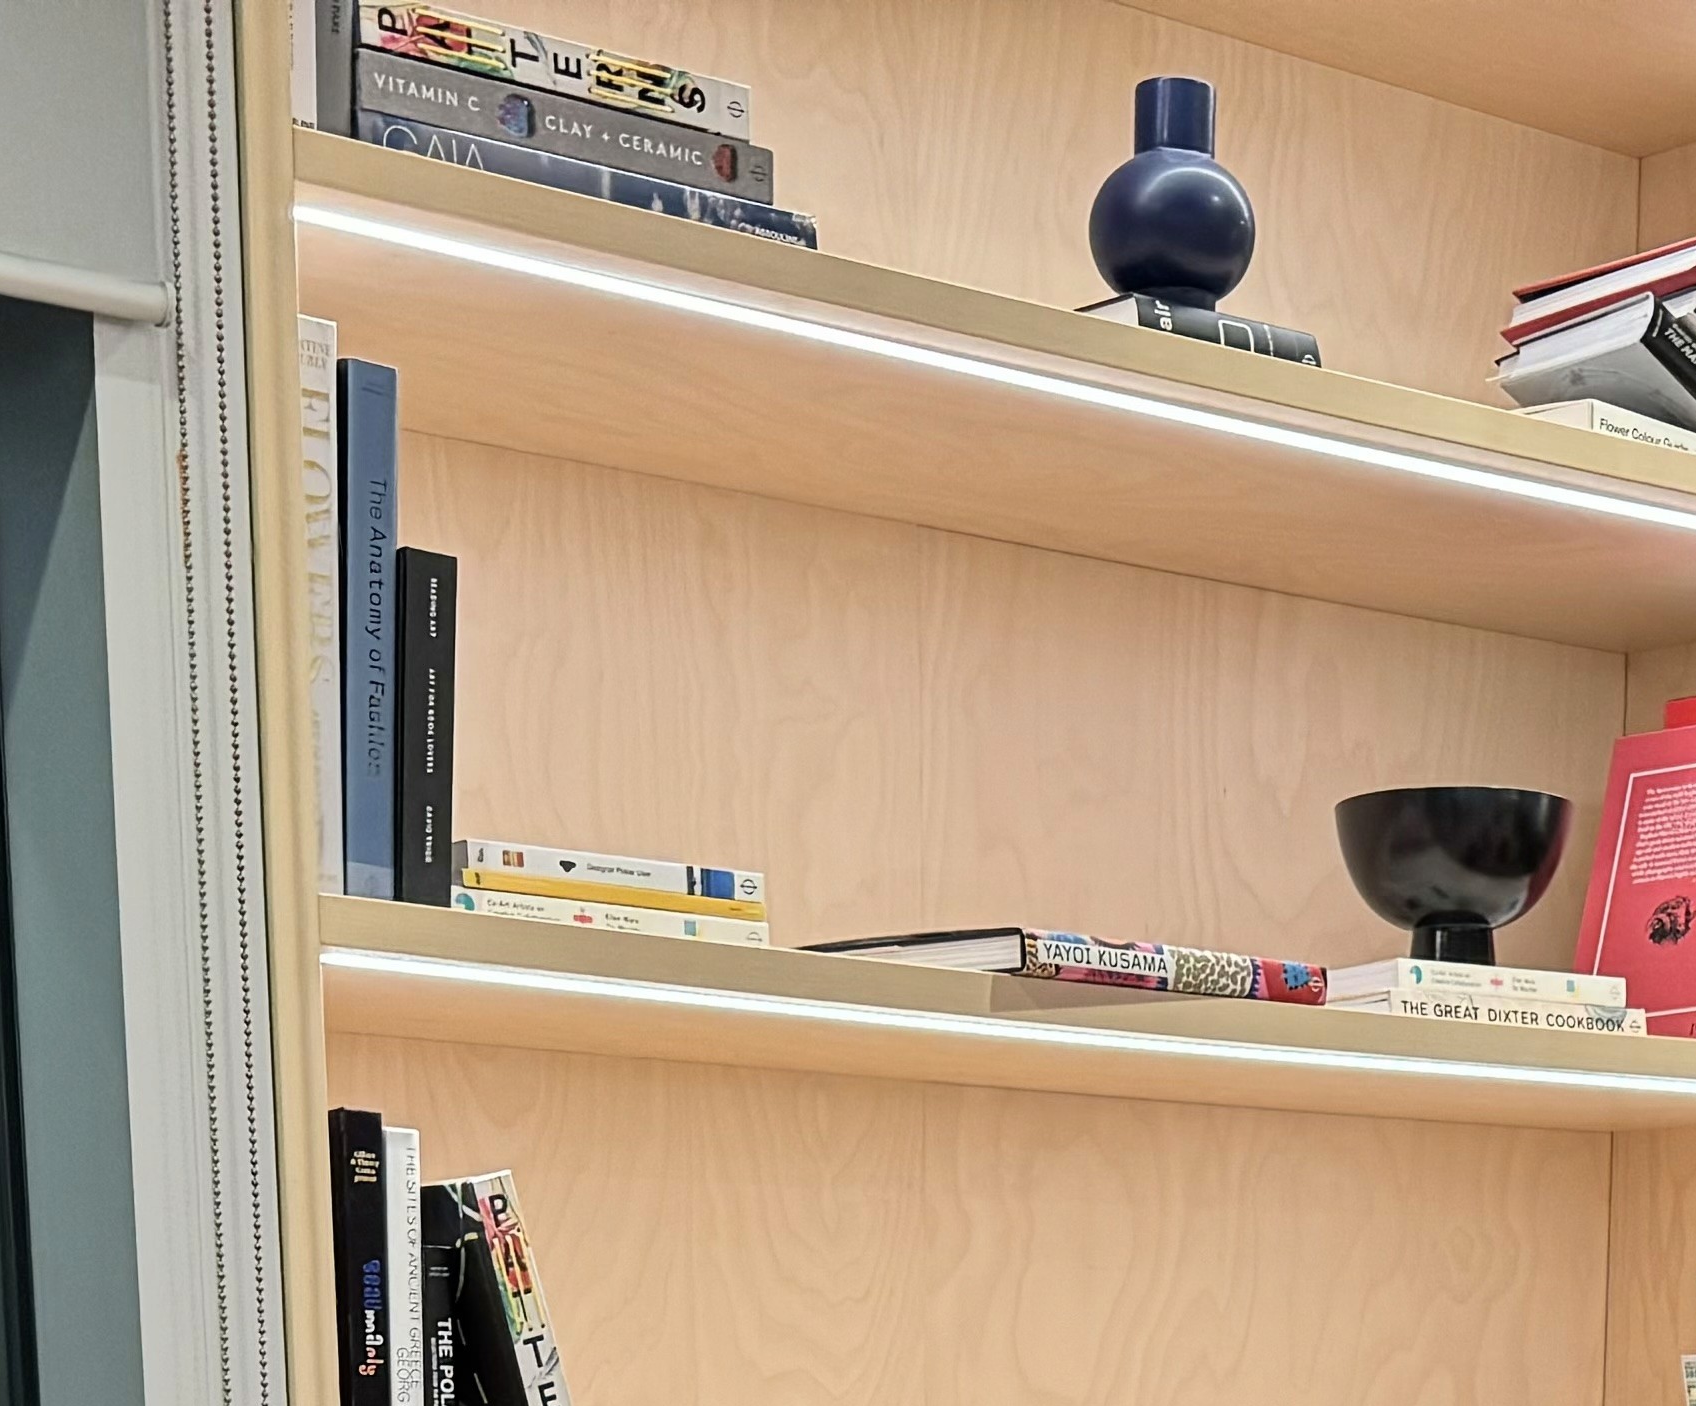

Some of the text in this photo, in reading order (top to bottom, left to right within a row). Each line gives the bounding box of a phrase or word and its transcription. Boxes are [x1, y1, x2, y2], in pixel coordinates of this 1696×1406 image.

[374, 73, 481, 111] VITAMIN C
[545, 115, 593, 139] CLAY
[619, 133, 703, 166] CERAMIC
[1664, 328, 1684, 353] THE
[1599, 417, 1630, 437] Flower
[369, 478, 387, 520] The
[365, 526, 387, 641] Anatomy
[369, 649, 386, 677] of
[1043, 942, 1168, 975] YAYOI KUSAMA
[1401, 1000, 1625, 1032] THE GREAT DIXTER COOKBOOK
[437, 1318, 454, 1357] THE
[396, 1346, 409, 1403] GEORG
[409, 1327, 423, 1389] GREECE
